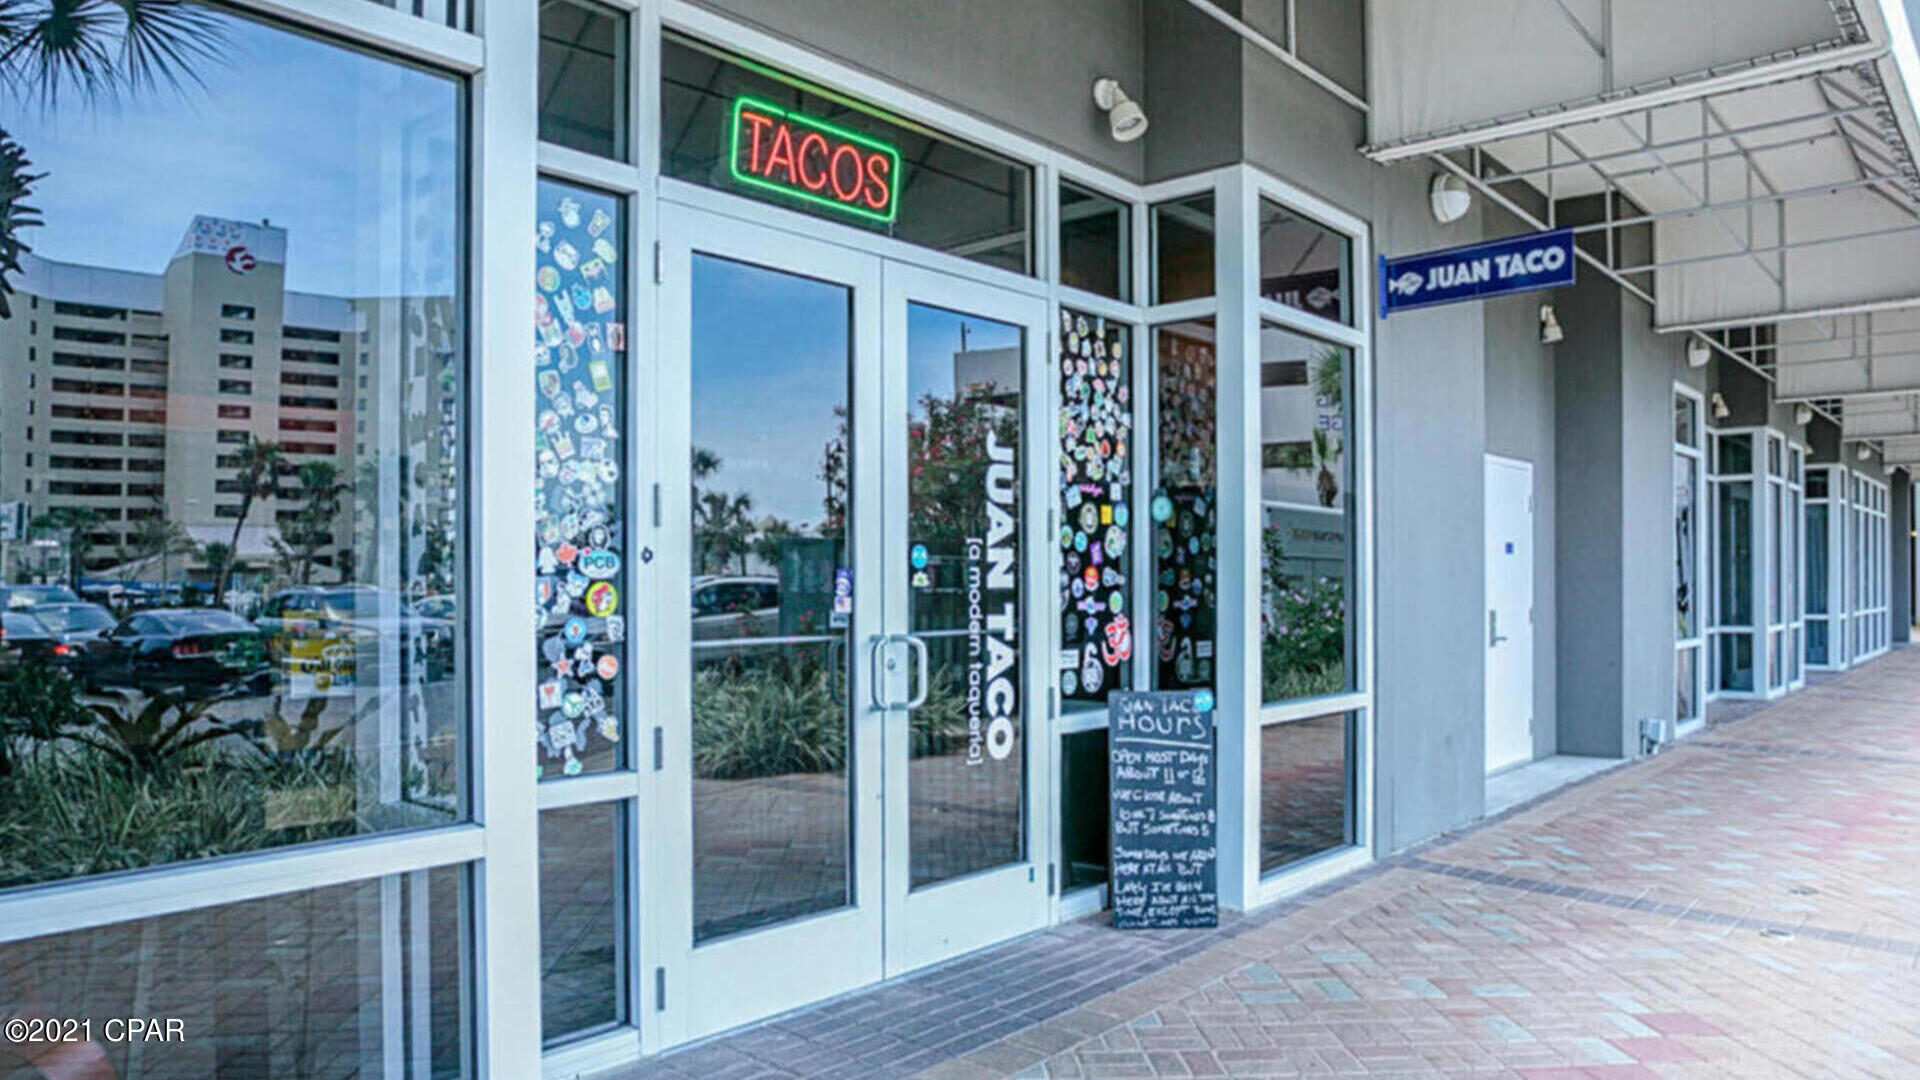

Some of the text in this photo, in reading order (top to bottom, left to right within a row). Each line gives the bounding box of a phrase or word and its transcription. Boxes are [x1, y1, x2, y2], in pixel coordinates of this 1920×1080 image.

[741, 112, 890, 209] TACOS
[1426, 245, 1567, 291] JUAN TACO
[583, 556, 616, 569] PCB
[985, 428, 1015, 761] JUAN TACO
[1144, 750, 1178, 763] MOST
[1115, 766, 1160, 779] ABOUT
